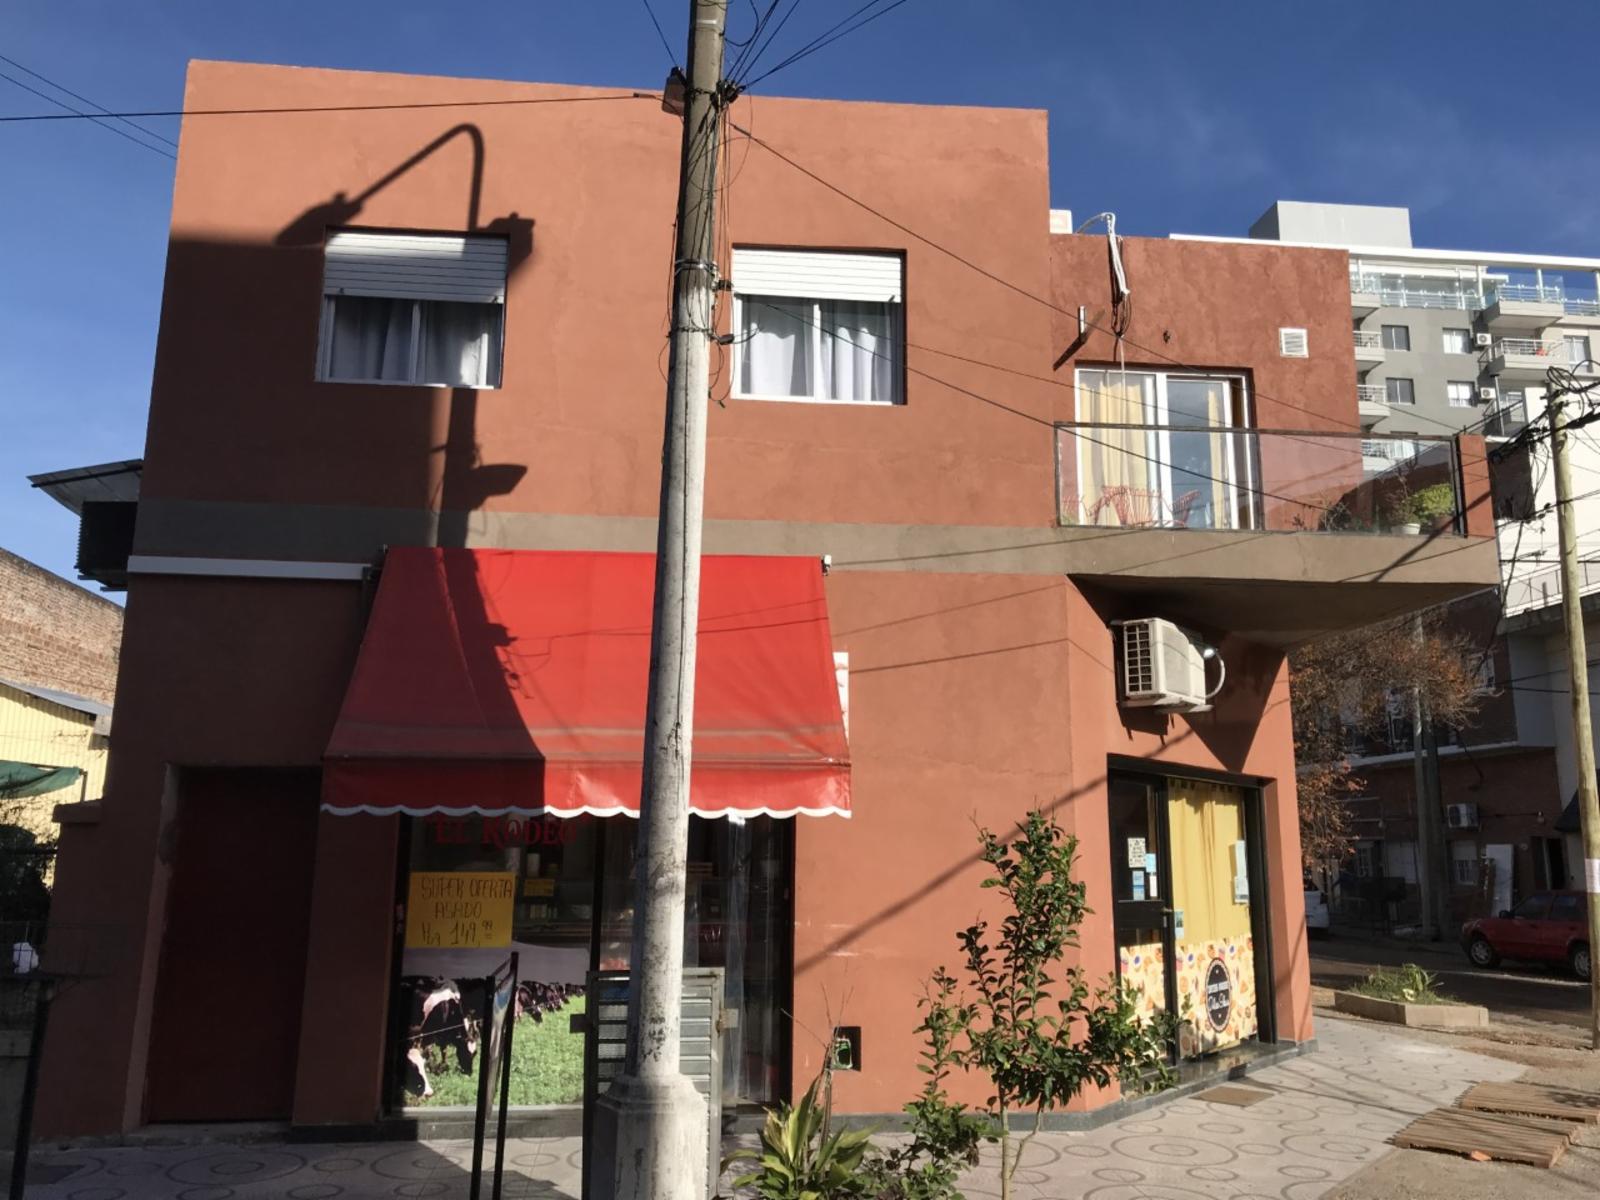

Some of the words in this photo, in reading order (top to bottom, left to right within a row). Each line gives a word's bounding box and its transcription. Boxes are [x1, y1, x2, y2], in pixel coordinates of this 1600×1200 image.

[422, 877, 463, 898] SUPER
[470, 878, 513, 899] OFERTA
[434, 901, 482, 920] ASADO
